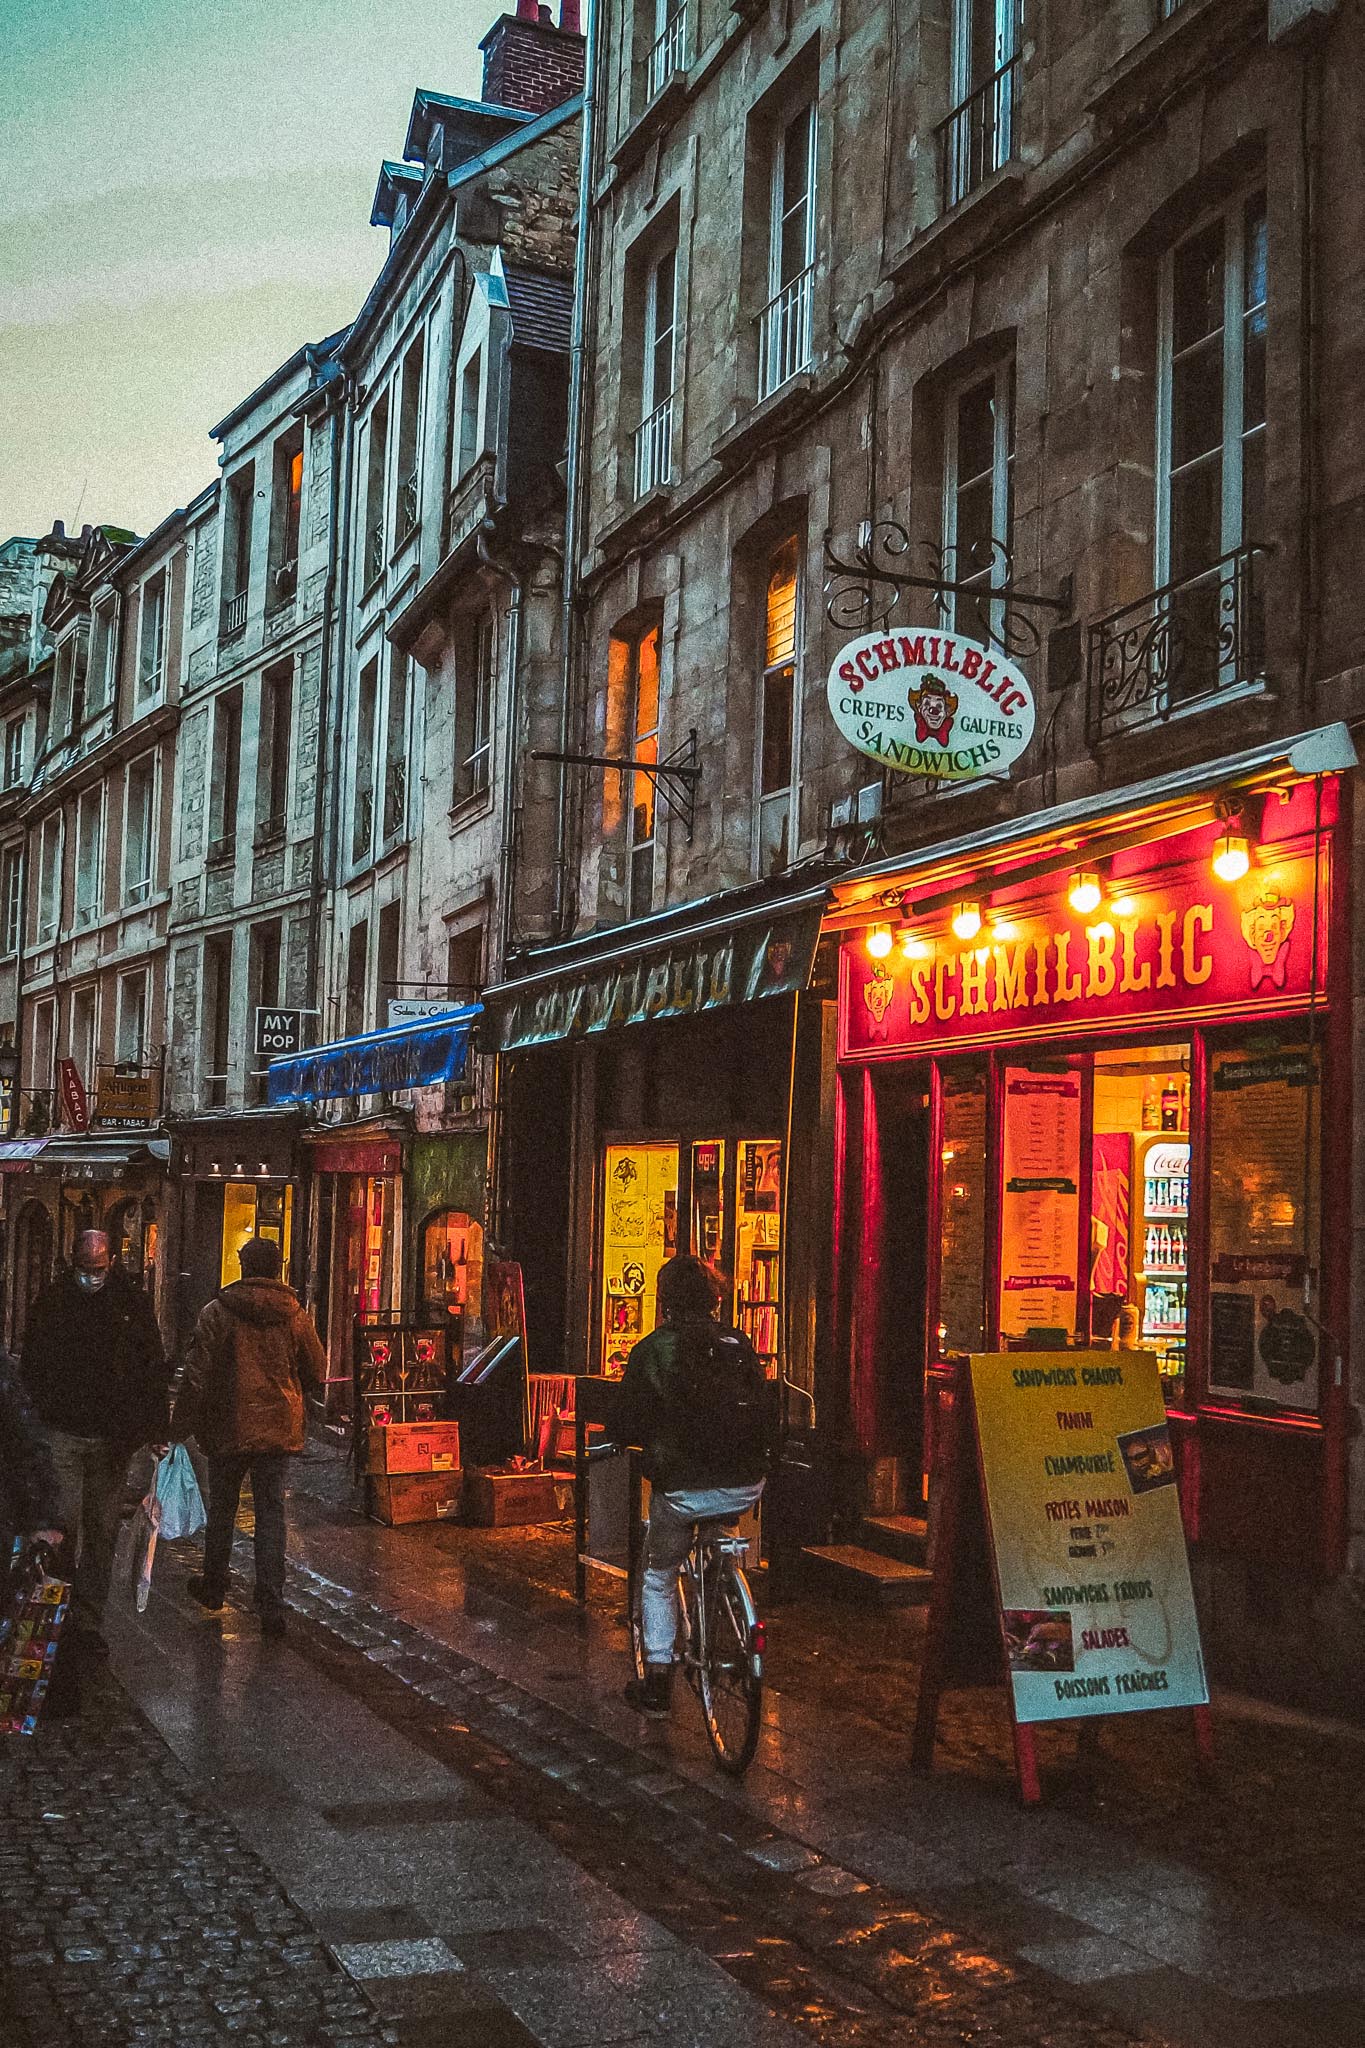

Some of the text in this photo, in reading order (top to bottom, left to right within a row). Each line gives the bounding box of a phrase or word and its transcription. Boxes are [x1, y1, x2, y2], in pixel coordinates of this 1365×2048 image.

[838, 635, 1028, 717] SCHMILBLIC
[839, 697, 1023, 740] CREPES GAUFRES
[856, 720, 1001, 773] SANDWICHS
[909, 903, 1213, 1025] SCHMILBLIC
[264, 1014, 294, 1031] MY
[263, 1034, 294, 1049] POP
[66, 1068, 84, 1122] TABAC
[101, 1118, 117, 1126] BAR
[122, 1119, 146, 1127] TABAC
[1012, 1367, 1077, 1387] SANDWICHS
[1056, 1411, 1094, 1430] PANINI
[1045, 1498, 1130, 1522] FRITES MAISON
[1043, 1579, 1154, 1606] SANDWICHS FROIDS
[1081, 1627, 1130, 1650] SALADES
[1054, 1675, 1111, 1701] BOISSONS
